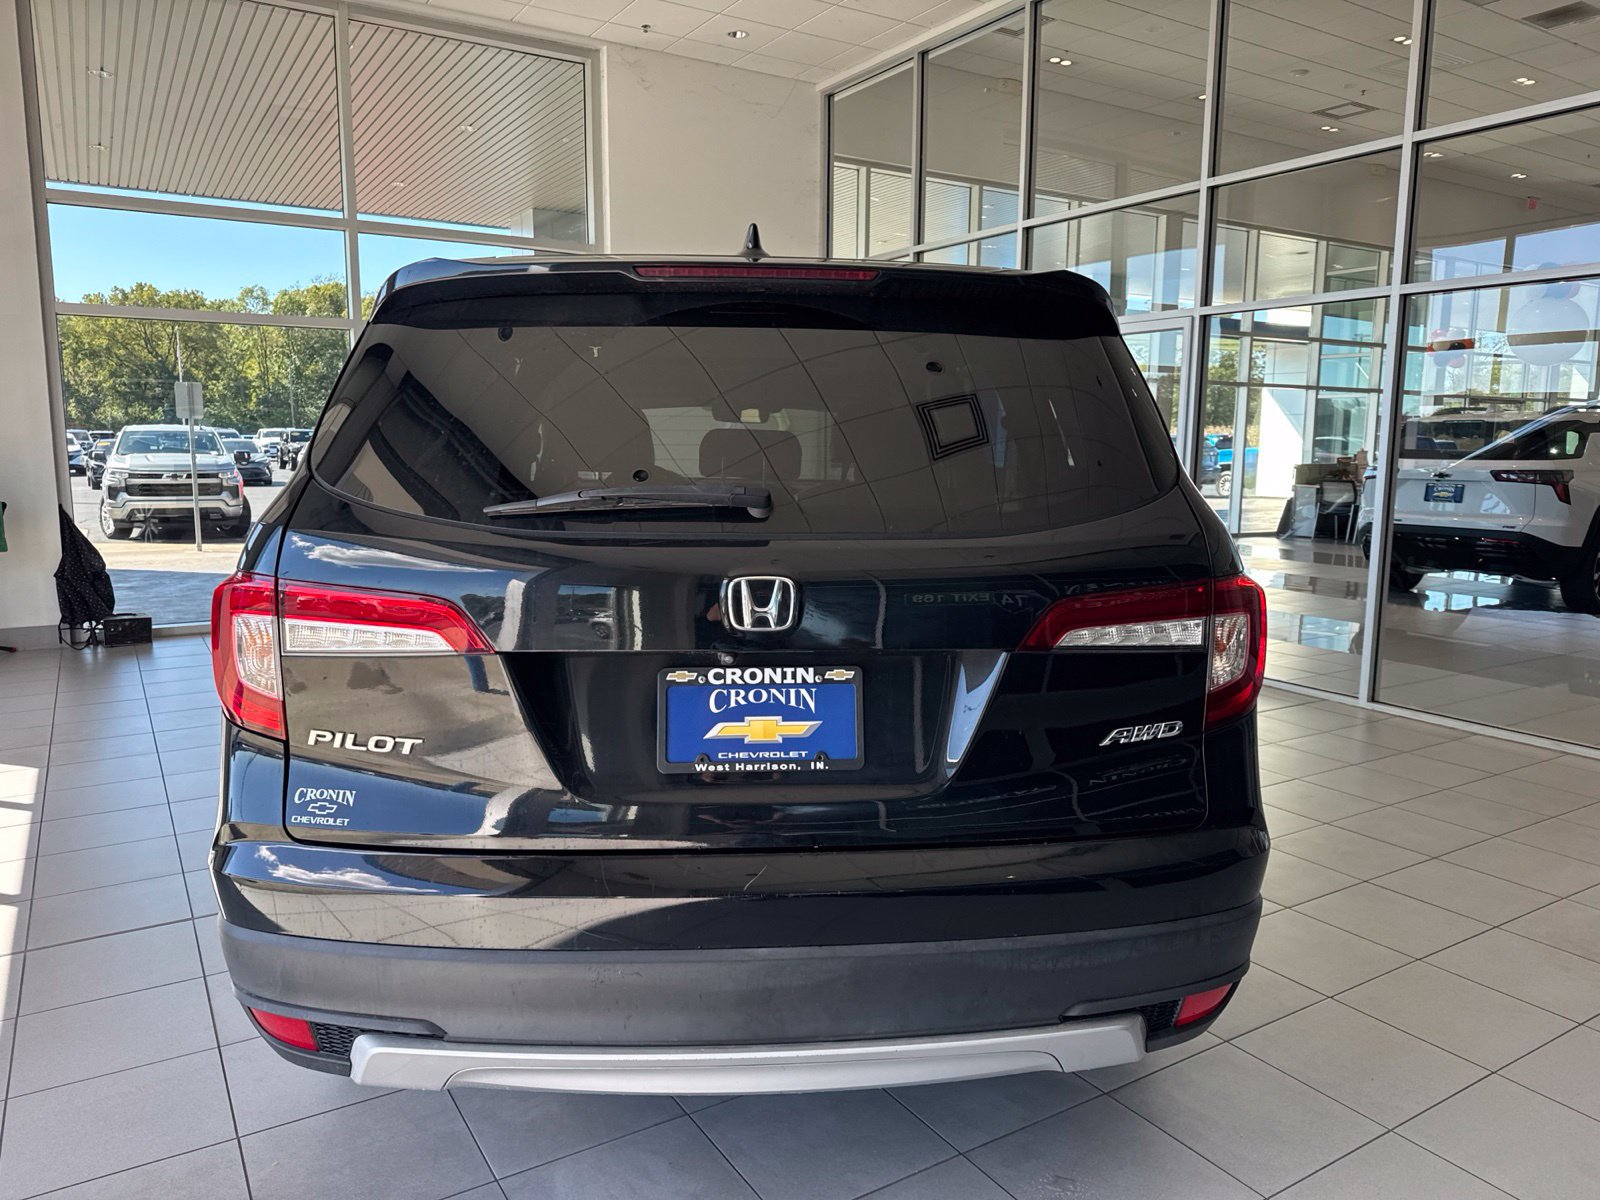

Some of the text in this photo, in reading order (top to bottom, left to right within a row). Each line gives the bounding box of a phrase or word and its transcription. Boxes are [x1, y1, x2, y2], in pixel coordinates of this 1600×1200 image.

[707, 667, 814, 685] CRONIN
[709, 688, 816, 714] CRONIN
[307, 729, 423, 755] PILOT
[1099, 721, 1184, 747] AWD
[717, 750, 809, 760] CHEVROLET
[694, 761, 830, 772] West Harrison, IN.
[294, 788, 356, 807] CRONIN
[291, 815, 350, 827] CHEVROLET
